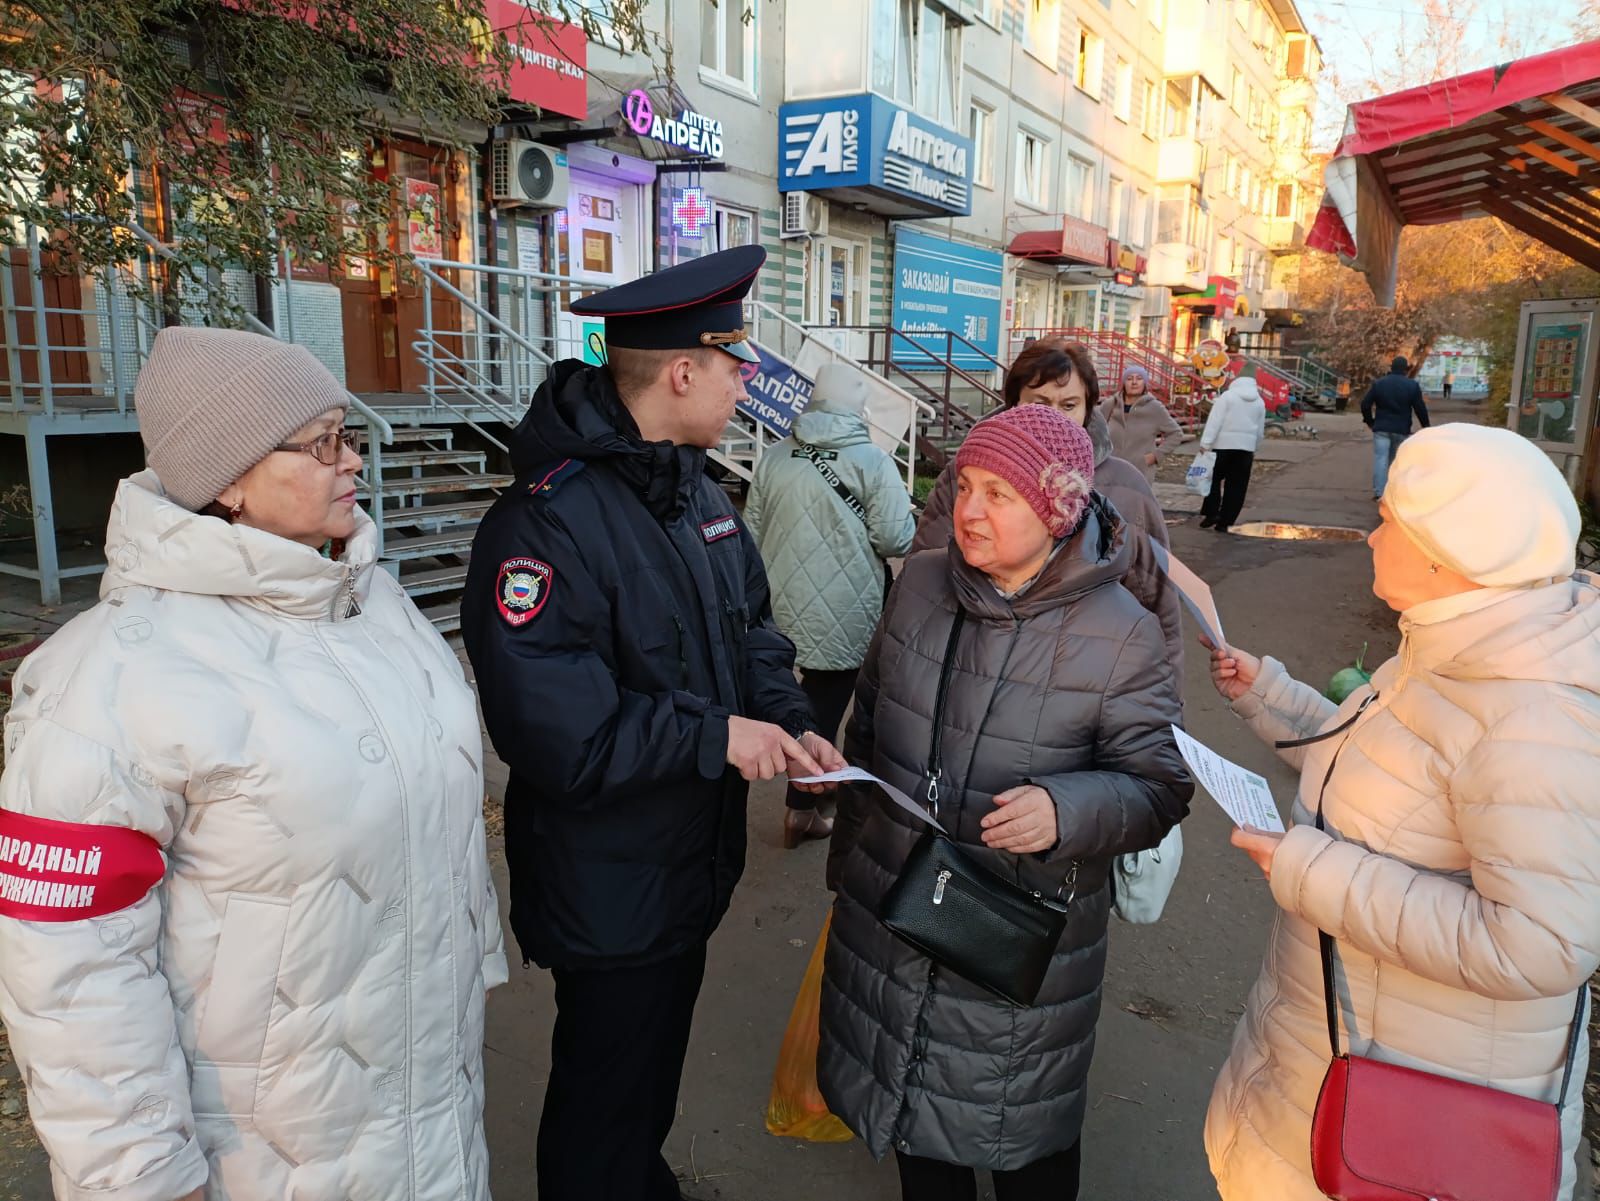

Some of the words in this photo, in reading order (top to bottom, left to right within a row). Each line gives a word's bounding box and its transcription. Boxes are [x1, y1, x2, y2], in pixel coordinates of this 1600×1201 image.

[507, 43, 585, 80] ОНДИТЕРСКАЯ
[682, 109, 723, 135] АПТЕКА
[651, 115, 724, 158] АПРЕЛЬ
[843, 109, 859, 171] ПЛЮС
[902, 268, 950, 295] ЗАКАЗЫВАЙ
[750, 372, 809, 414] АПРЕ
[785, 374, 815, 397] АПТ
[799, 441, 817, 459] TO
[814, 457, 840, 487] GILDA
[503, 559, 549, 577] ПОЛИЦИЯ
[507, 611, 526, 624] МВД
